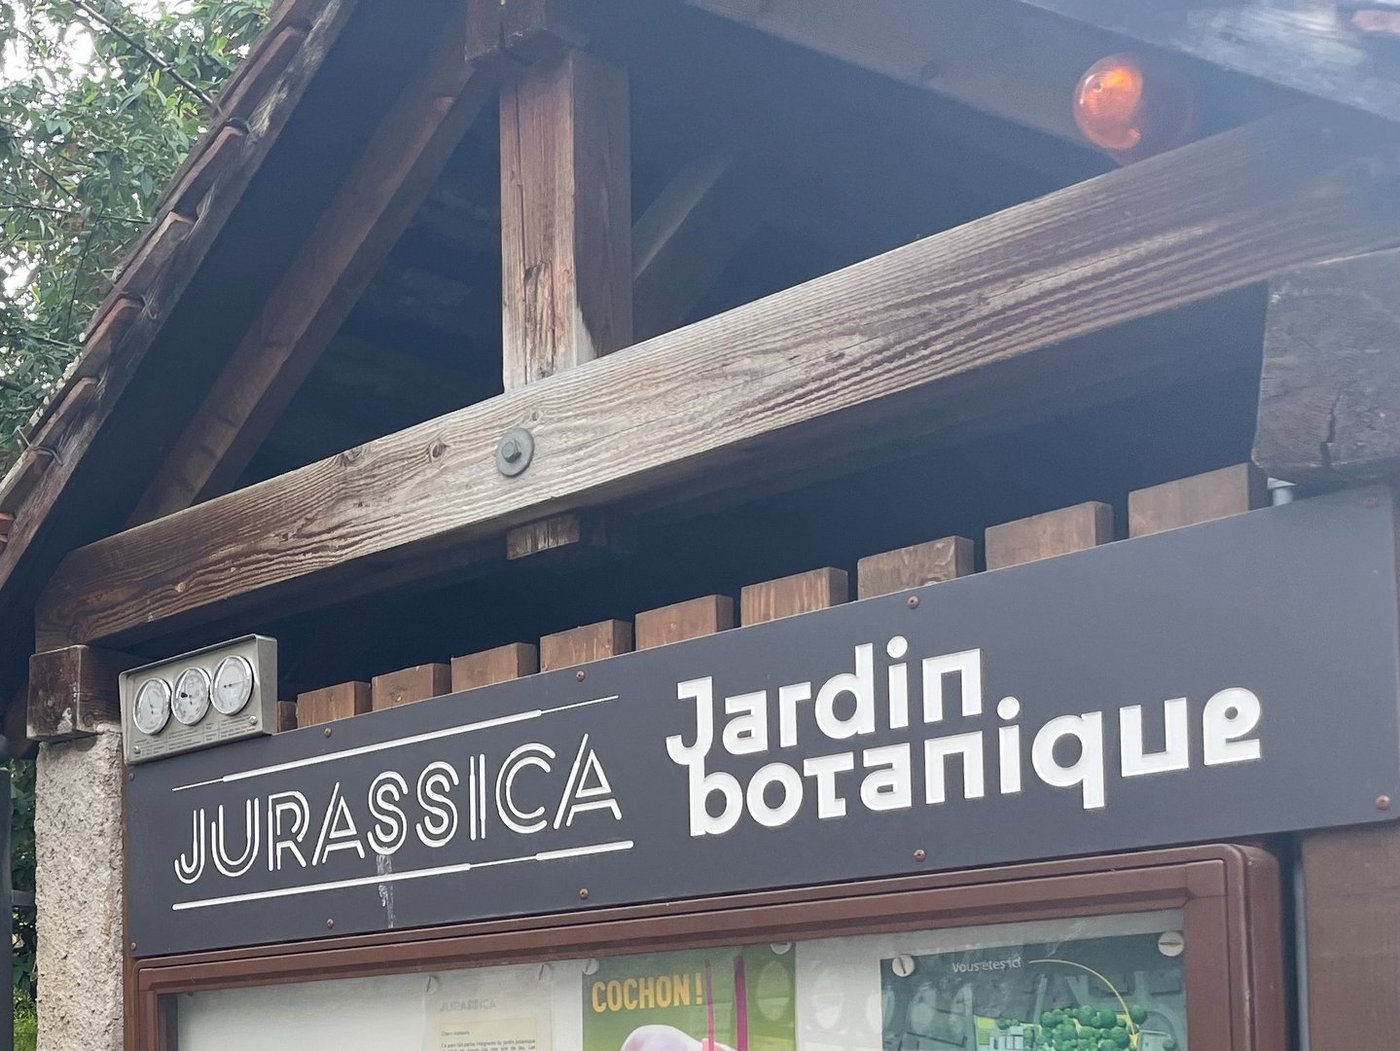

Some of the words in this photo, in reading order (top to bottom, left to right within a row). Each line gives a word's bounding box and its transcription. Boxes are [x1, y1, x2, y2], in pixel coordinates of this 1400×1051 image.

[666, 636, 982, 766] Jardin
[689, 686, 1261, 836] botanique
[173, 732, 622, 884] JURASSICA
[952, 962, 979, 972] Vous
